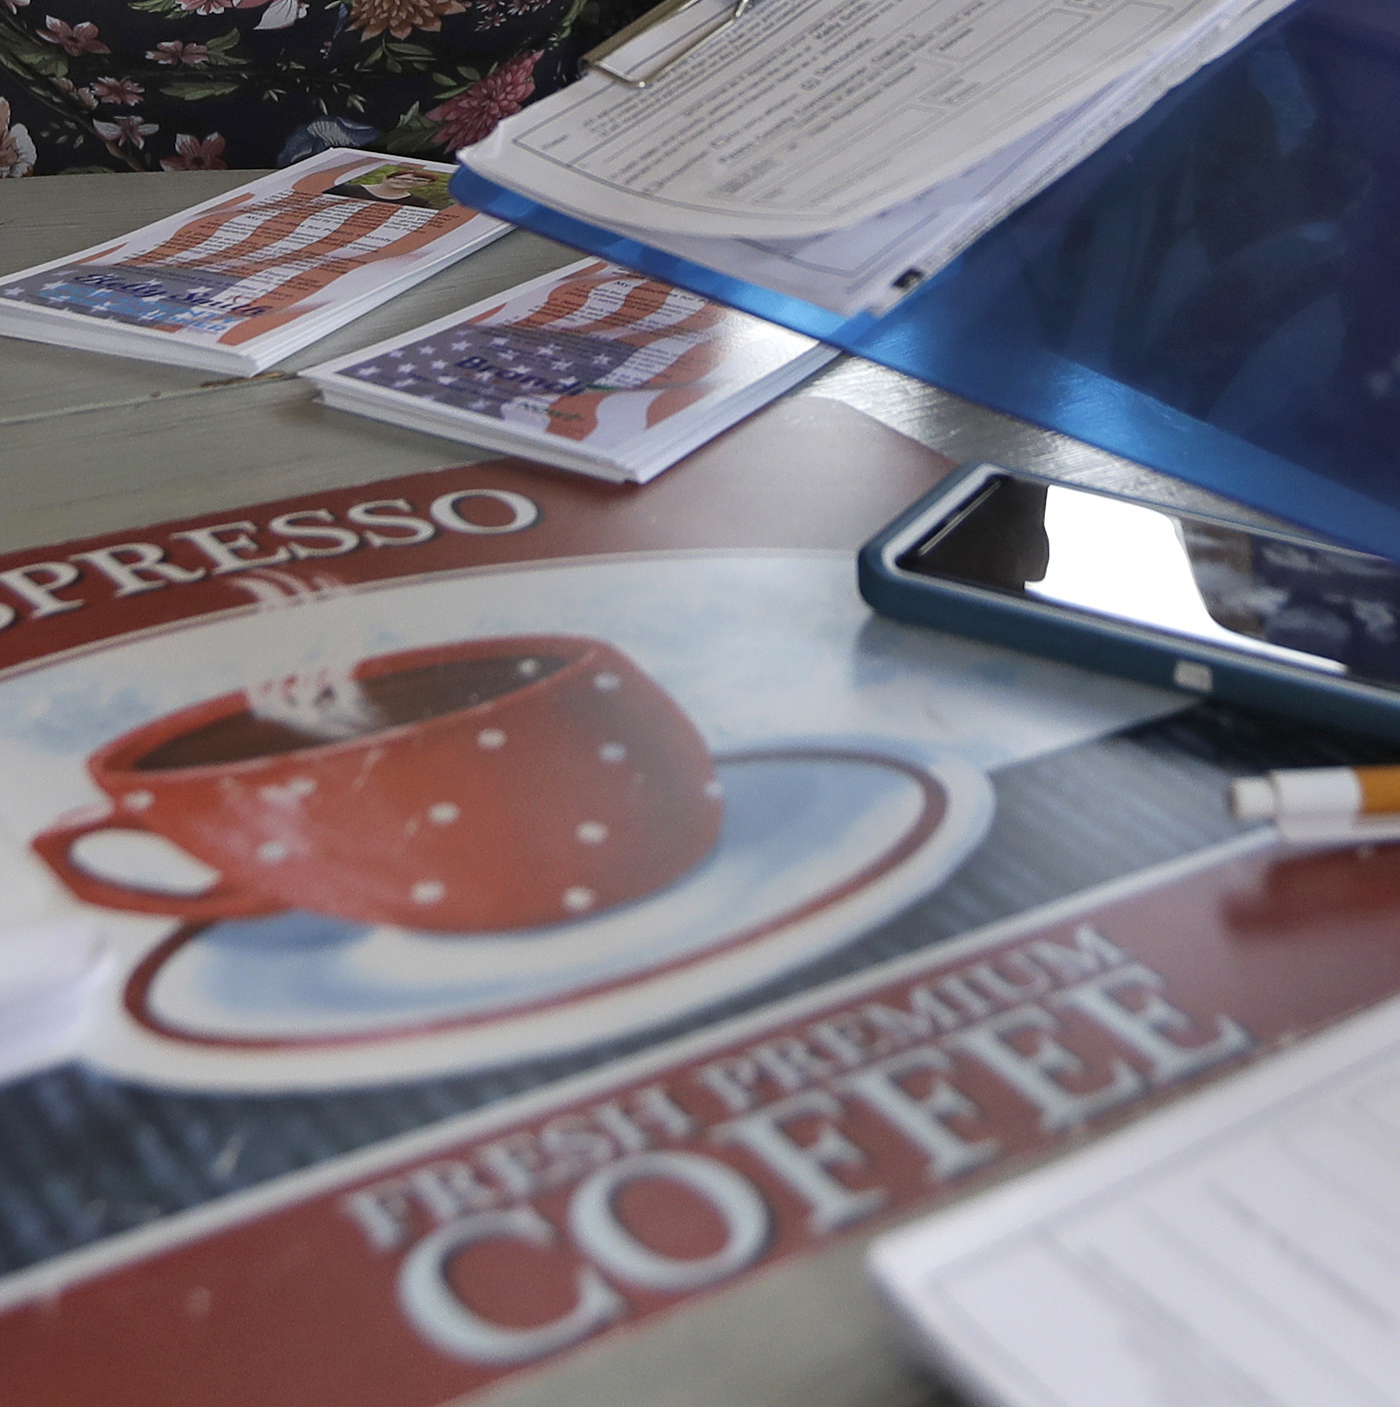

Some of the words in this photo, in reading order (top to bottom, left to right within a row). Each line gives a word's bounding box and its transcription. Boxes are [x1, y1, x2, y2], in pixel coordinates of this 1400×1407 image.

[344, 1081, 706, 1254] FRESH
[696, 920, 1134, 1116] PREMIUM
[398, 960, 1262, 1367] COFFEE
